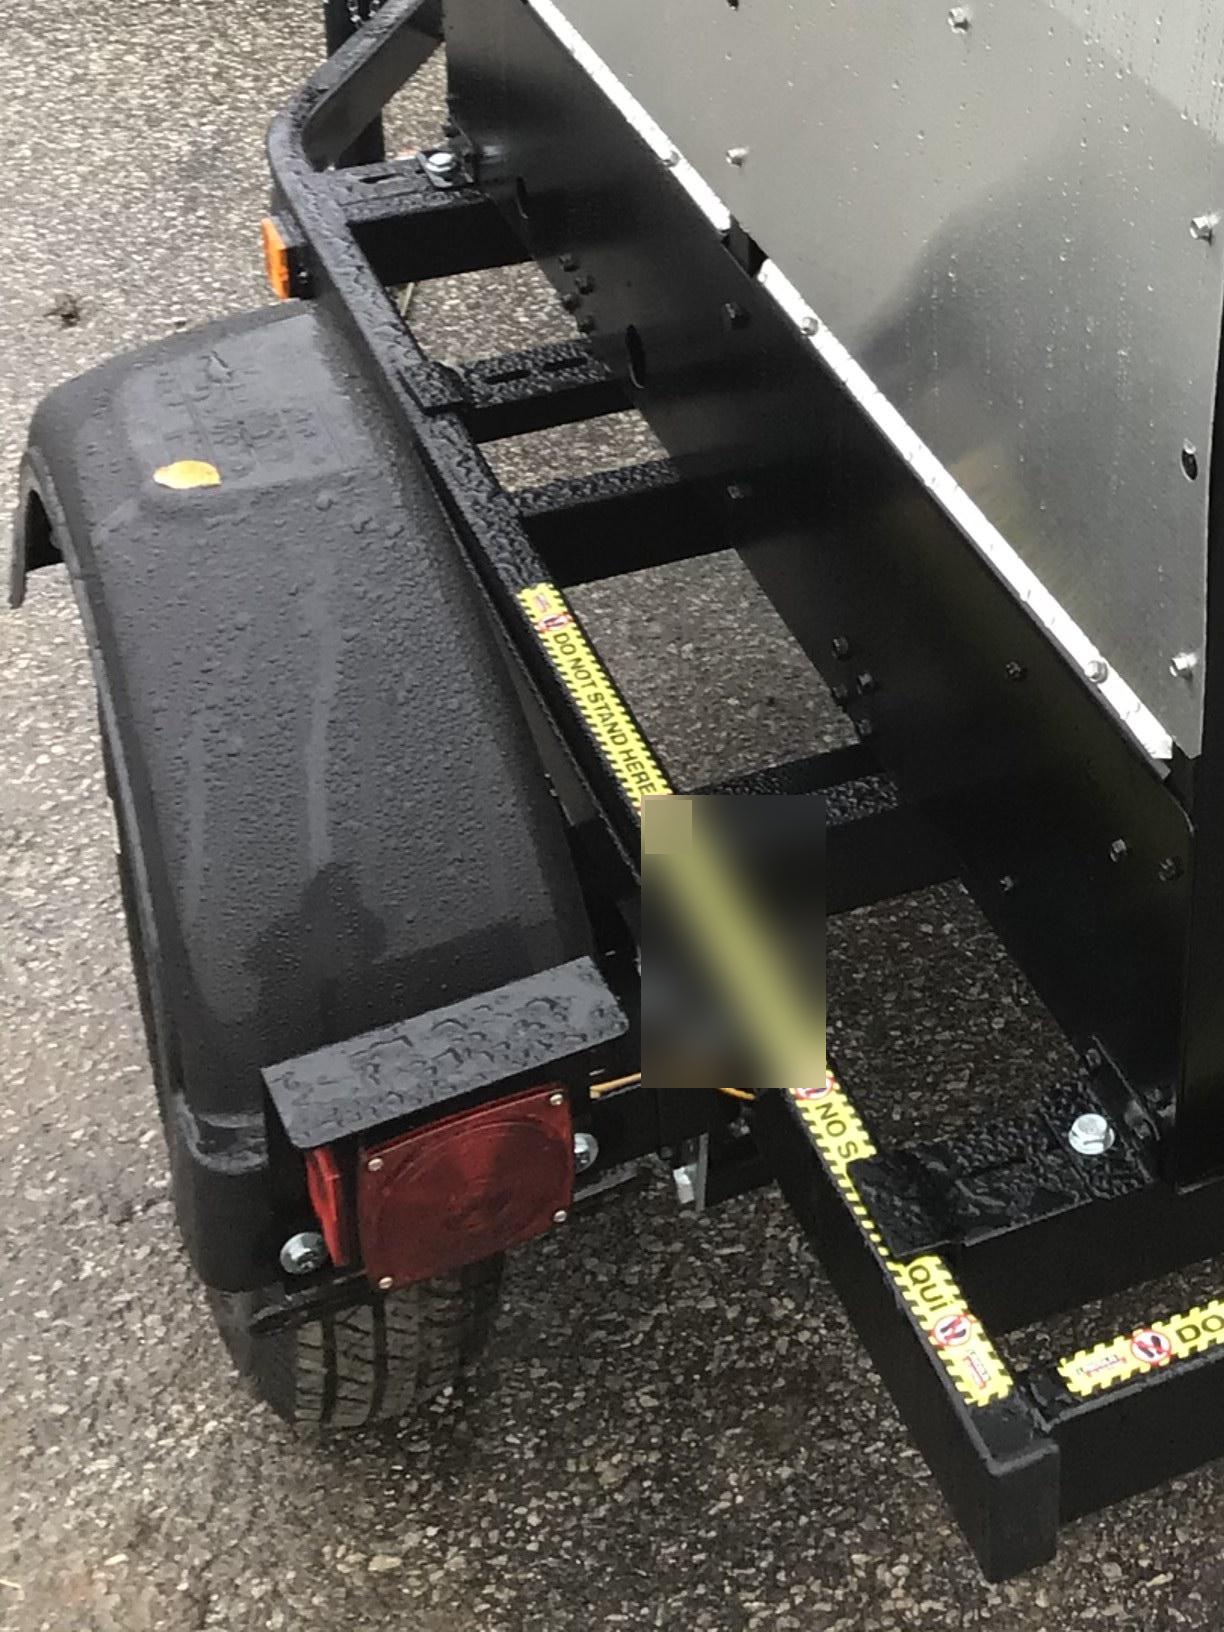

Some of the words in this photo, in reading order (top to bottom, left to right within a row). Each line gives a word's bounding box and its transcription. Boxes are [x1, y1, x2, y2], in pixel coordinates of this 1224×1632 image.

[553, 631, 577, 655] DO
[571, 656, 597, 690] NOT
[587, 693, 628, 746] STAND
[617, 744, 657, 795] HERE
[815, 1101, 848, 1138] NO
